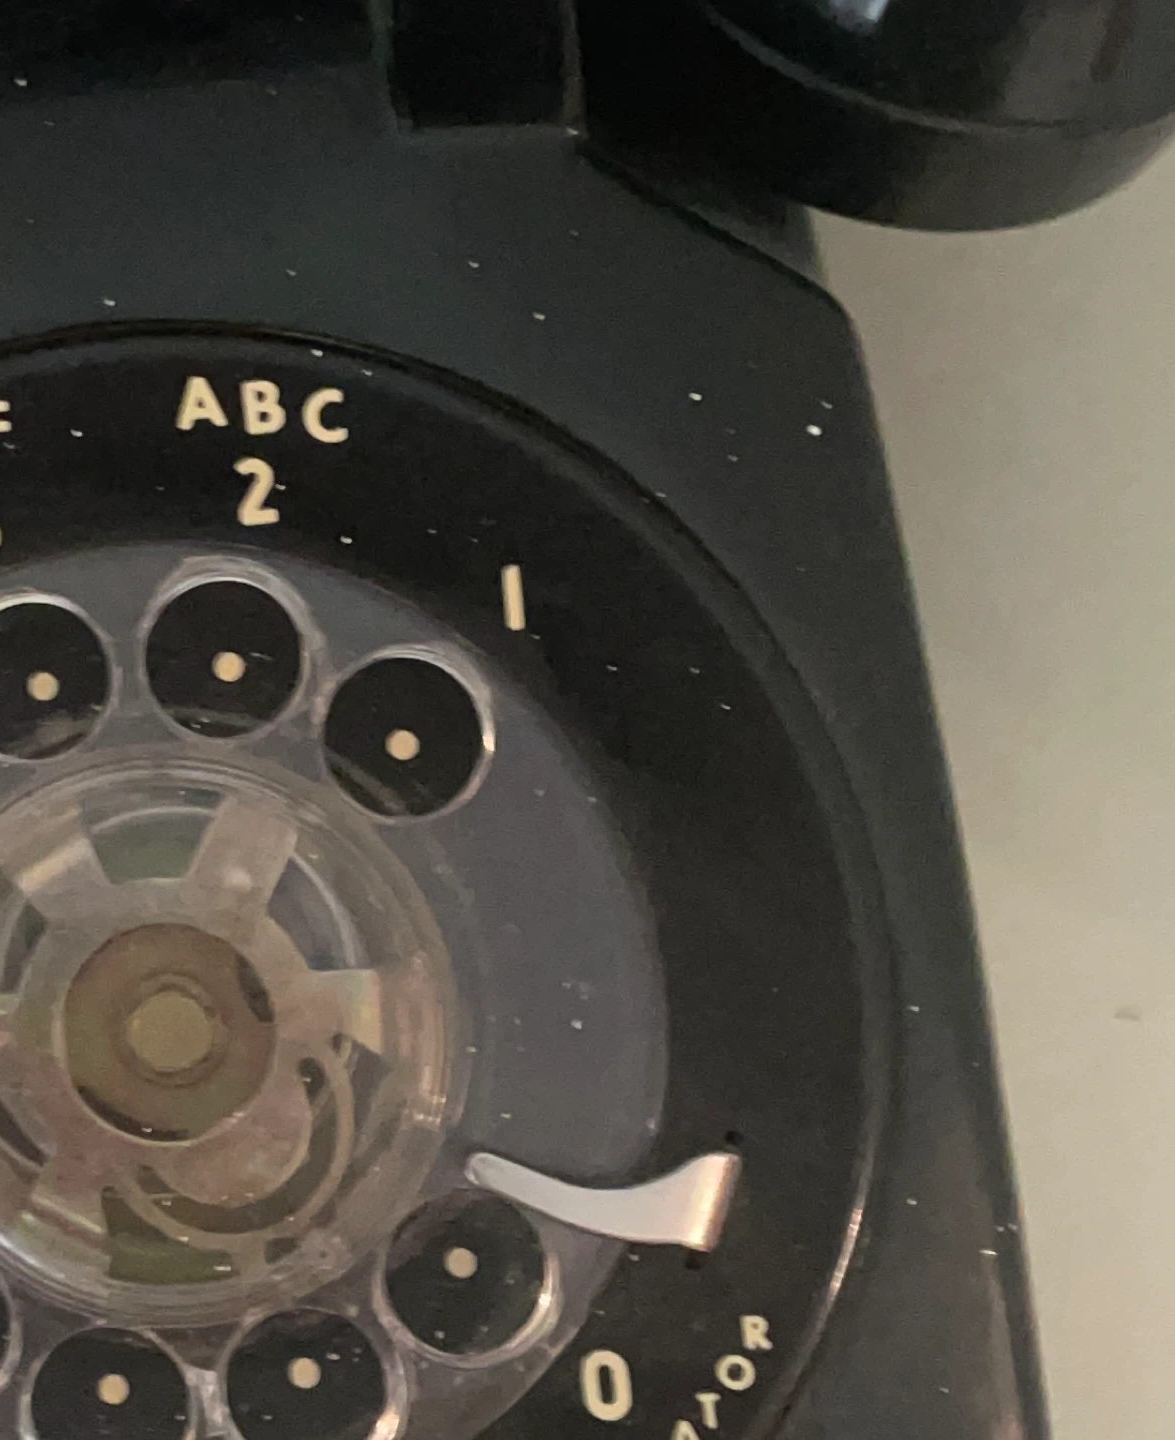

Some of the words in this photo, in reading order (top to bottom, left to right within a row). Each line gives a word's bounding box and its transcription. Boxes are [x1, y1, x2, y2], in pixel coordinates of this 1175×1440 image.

[176, 375, 349, 444] ABC
[234, 457, 280, 527] 2
[579, 1349, 633, 1423] 0
